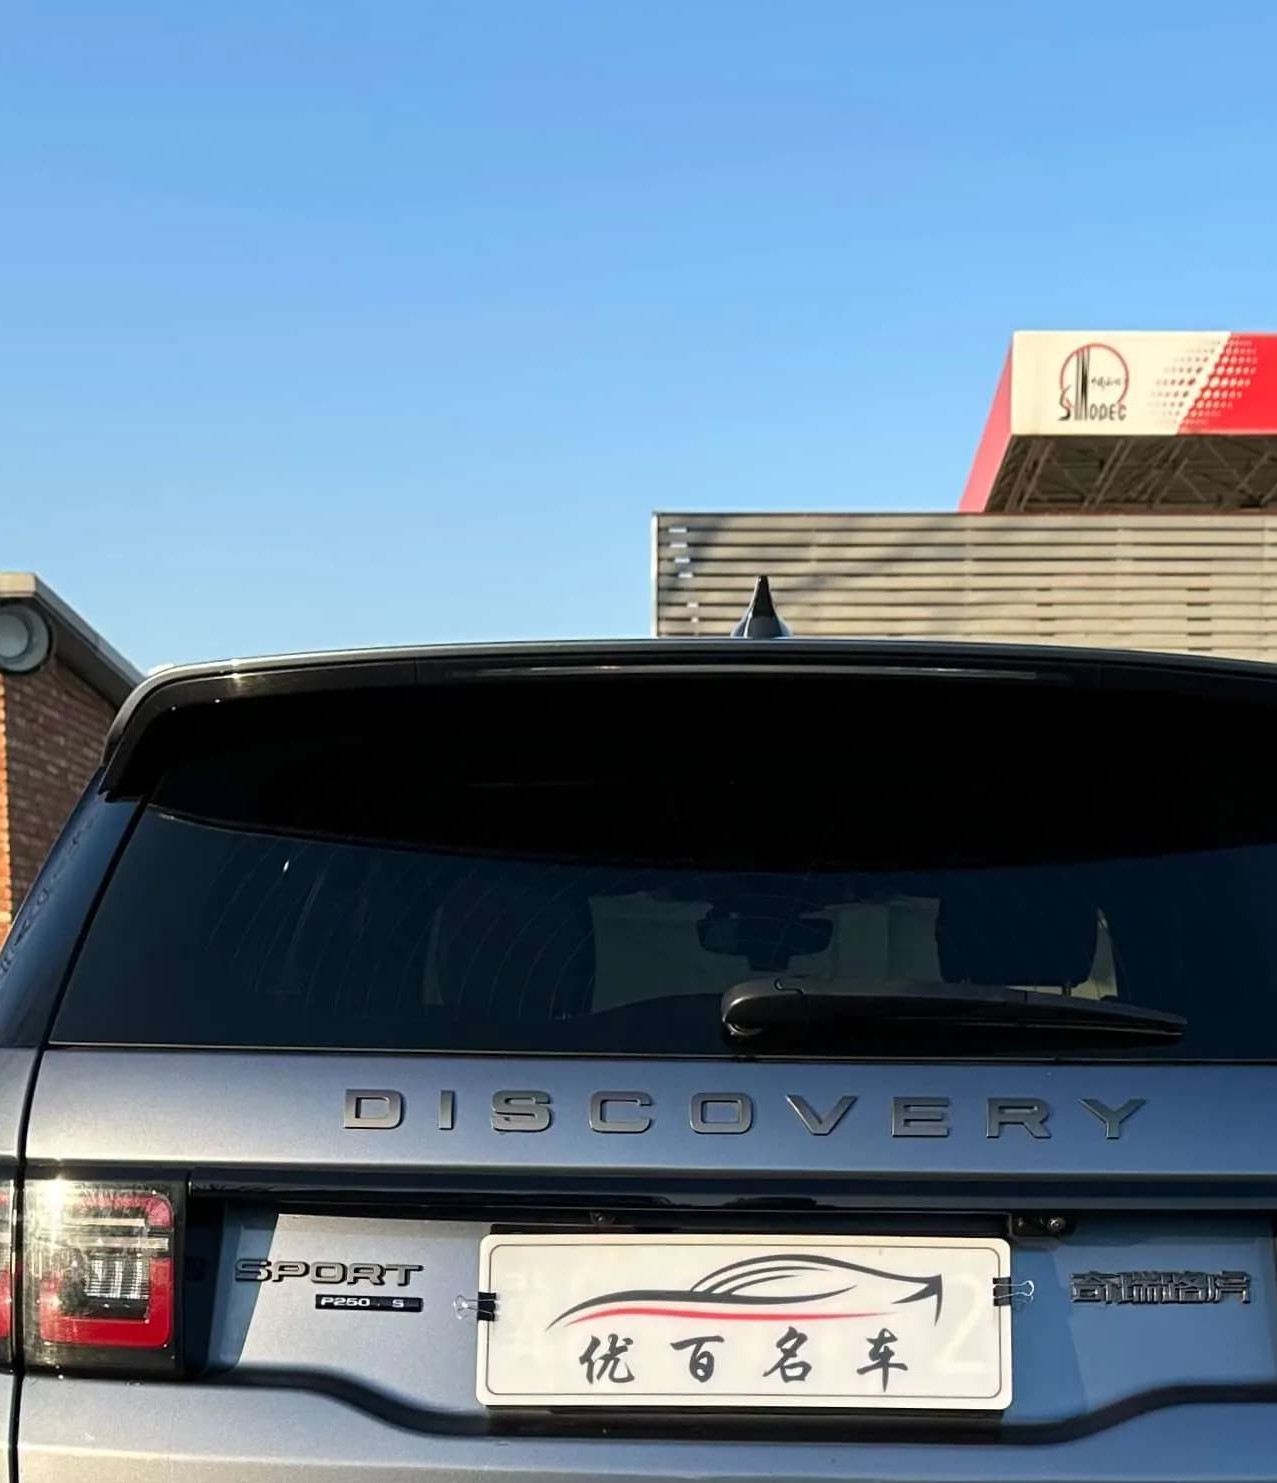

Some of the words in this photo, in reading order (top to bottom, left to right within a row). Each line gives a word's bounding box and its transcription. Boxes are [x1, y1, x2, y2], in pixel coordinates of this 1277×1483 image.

[342, 1087, 1147, 1140] DISCOVERY
[235, 1258, 424, 1287] SPORT
[321, 1296, 371, 1308] P250
[578, 1326, 909, 1392] 优百名车
